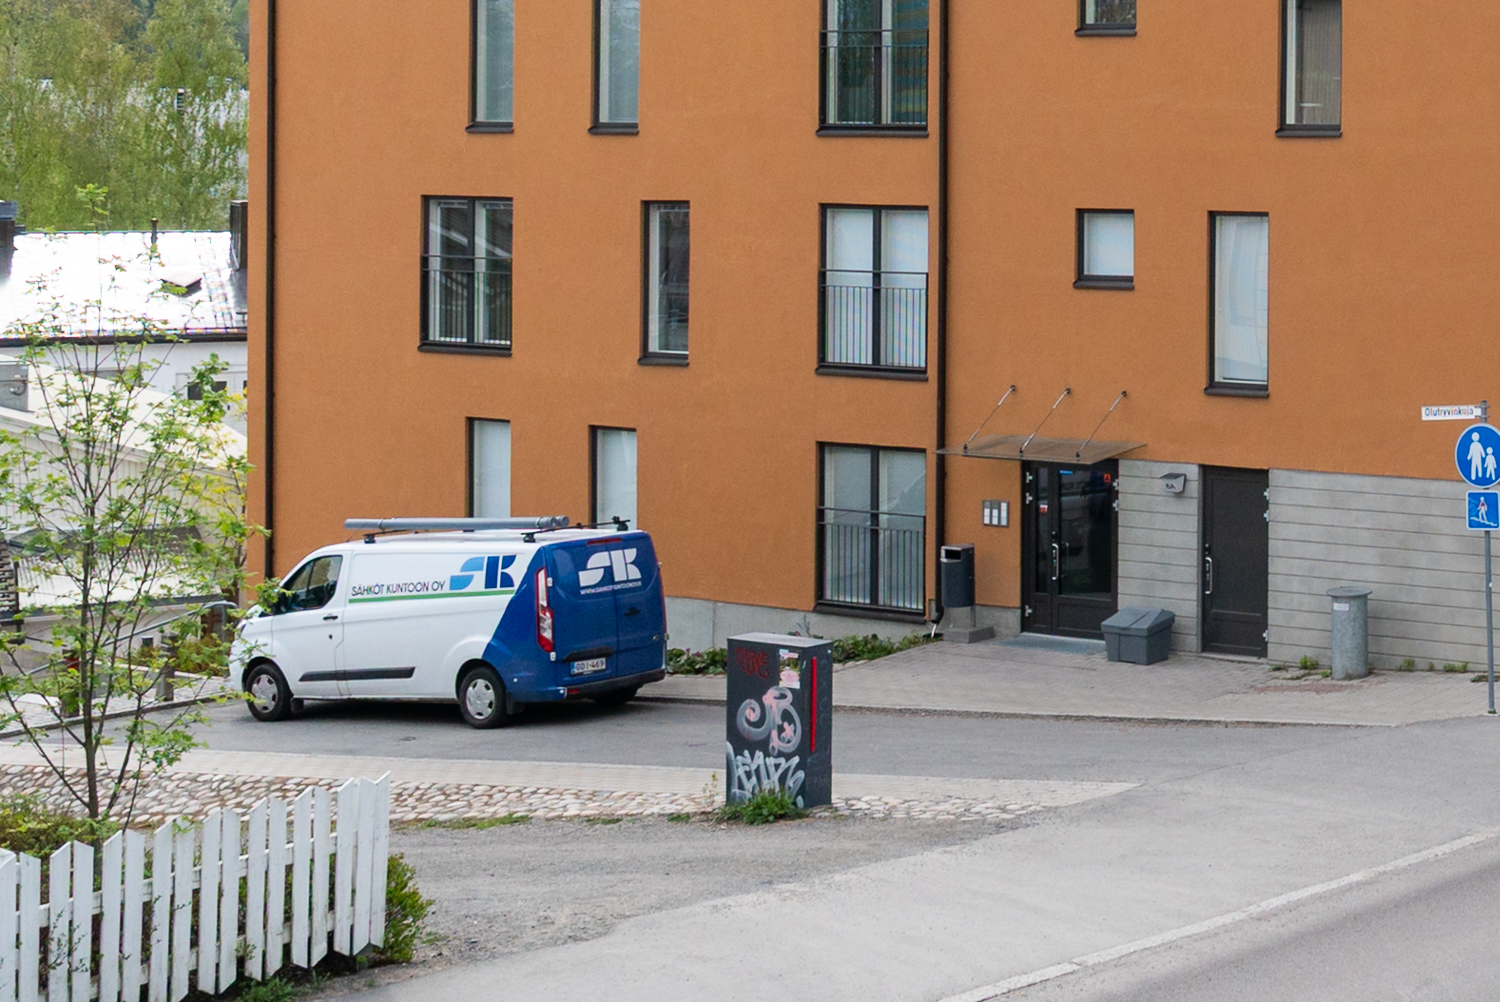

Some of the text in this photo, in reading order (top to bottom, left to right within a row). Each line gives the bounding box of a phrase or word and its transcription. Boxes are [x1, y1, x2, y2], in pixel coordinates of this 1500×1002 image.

[351, 580, 446, 597] SÄHKÖT KUNTOON OY
